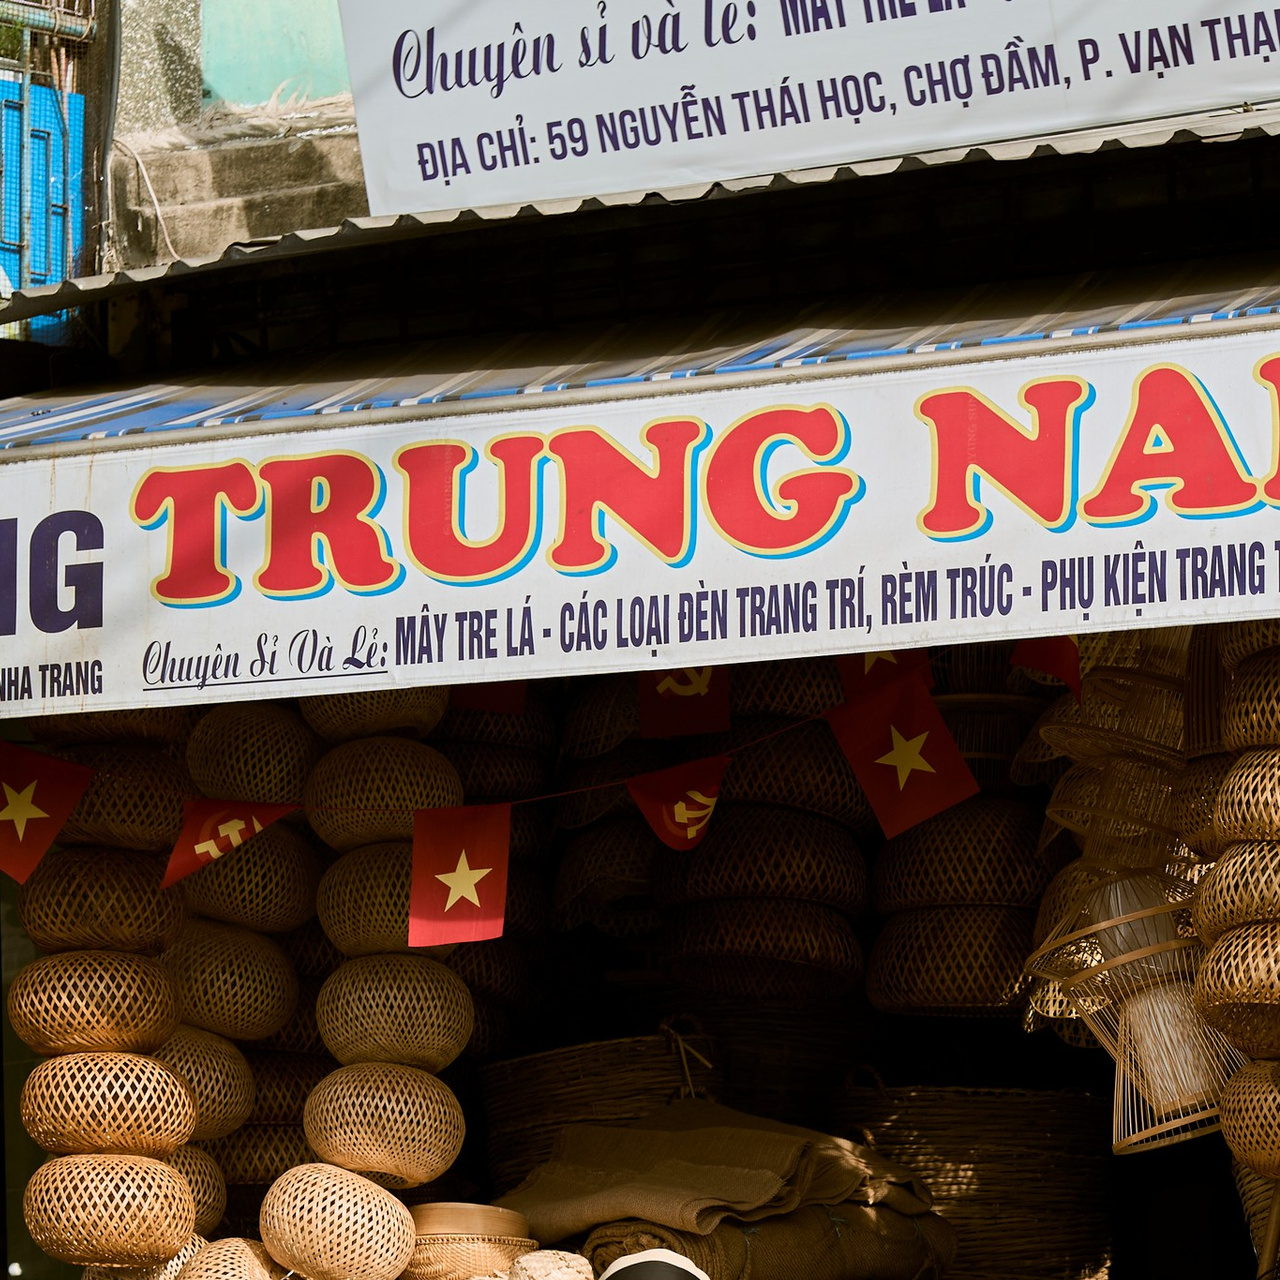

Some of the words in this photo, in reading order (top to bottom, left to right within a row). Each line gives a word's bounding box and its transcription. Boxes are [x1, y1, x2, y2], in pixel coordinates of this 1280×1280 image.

[393, 22, 563, 99] Chuyên
[631, 0, 689, 60] và
[416, 137, 472, 186] ĐỊA
[476, 114, 540, 172] CHỈ:
[546, 117, 589, 161] 59
[595, 84, 728, 154] NGUYỄN
[732, 76, 811, 132] THÁI
[817, 71, 897, 124] HỌC,
[903, 54, 973, 108] CHỢ
[980, 35, 1071, 97] ĐẦM,
[1078, 38, 1113, 81] P.
[1118, 22, 1196, 80] VẠN
[129, 401, 867, 610] TRUNG
[38, 659, 103, 699] TRANG
[142, 640, 242, 690] Chuyên
[288, 629, 335, 674] Và
[342, 625, 389, 671] Lẻ:
[395, 604, 448, 666] MÂY
[455, 608, 498, 661] TRE
[506, 595, 535, 657] LÁ
[560, 590, 608, 653] CÁC
[616, 593, 670, 657] LOẠI
[677, 580, 729, 644] ĐÈN
[736, 580, 818, 638] TRANG
[826, 565, 873, 634] TRÍ,
[881, 561, 939, 626] RÈM
[946, 553, 1014, 620] TRÚC
[1041, 556, 1095, 621] PHỤ
[1103, 540, 1168, 617] KIỆN
[1175, 541, 1266, 601] TRANG
